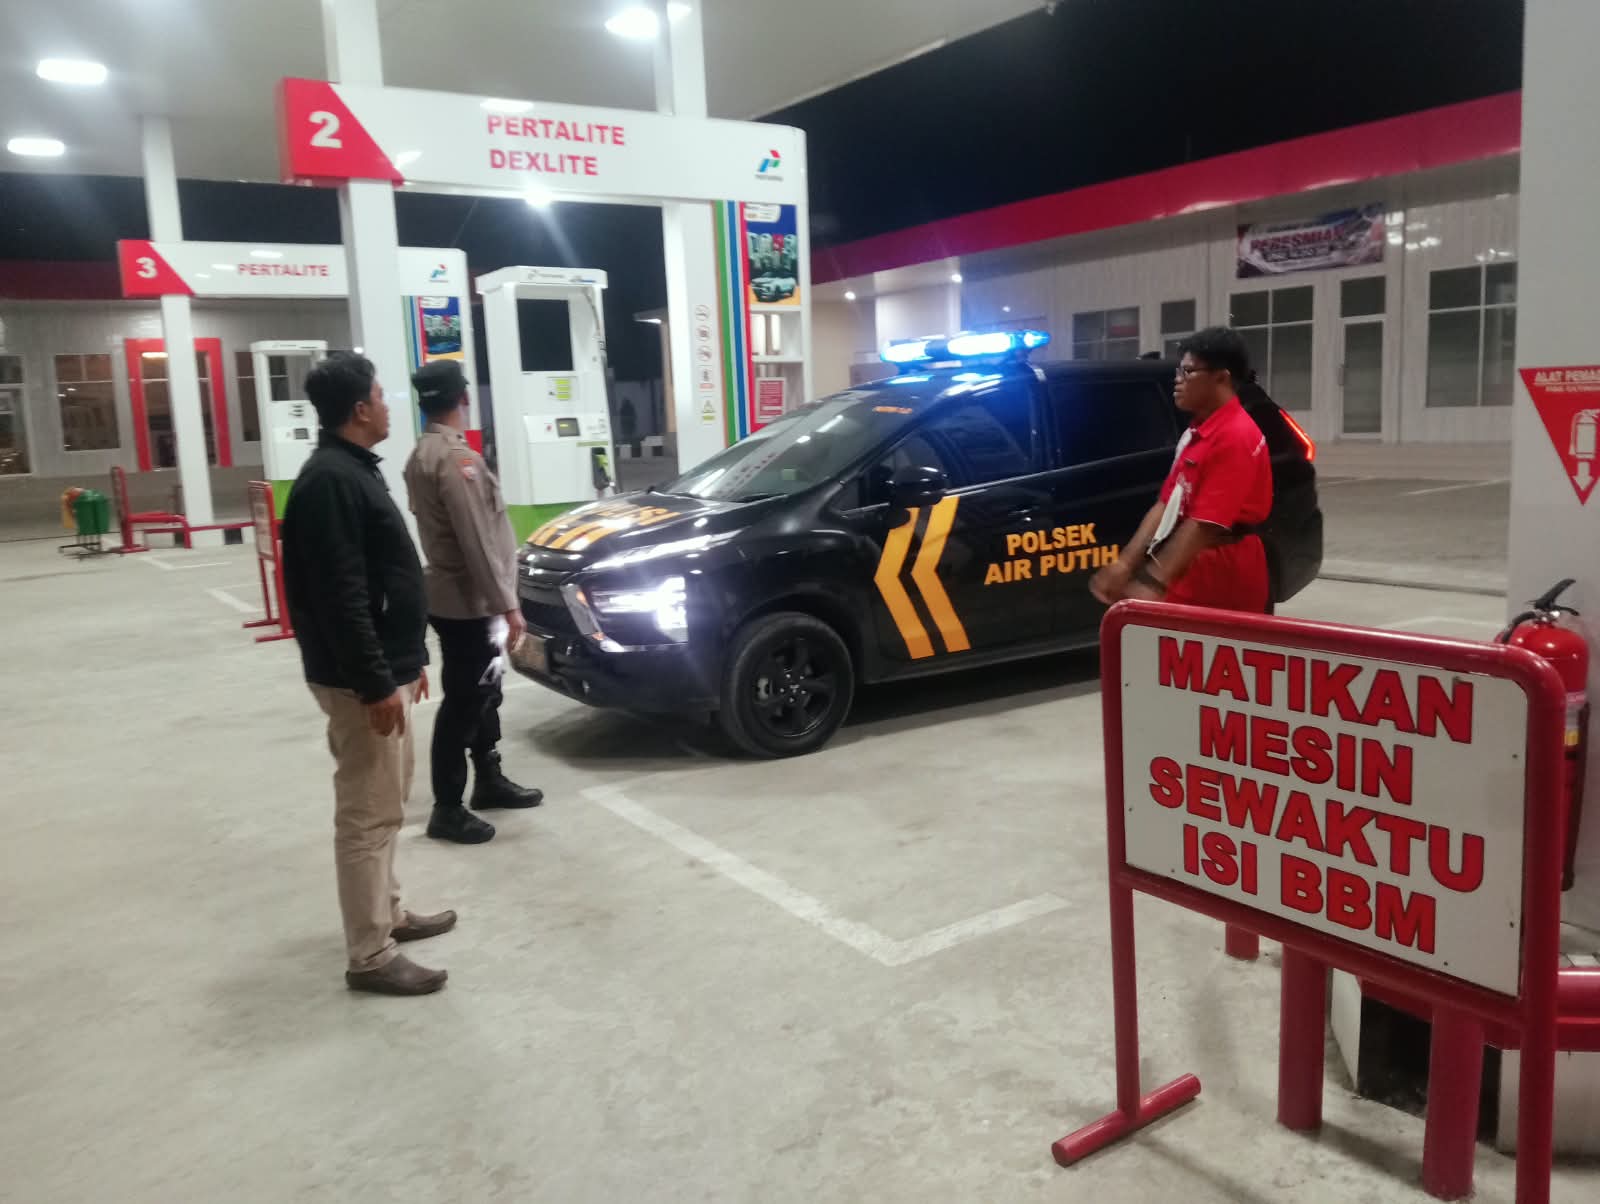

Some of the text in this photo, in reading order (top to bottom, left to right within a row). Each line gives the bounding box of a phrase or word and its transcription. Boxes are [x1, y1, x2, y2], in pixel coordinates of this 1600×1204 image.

[309, 111, 342, 149] 2
[487, 114, 625, 146] PERTALITE
[489, 149, 599, 176] DEXLITE
[136, 257, 158, 279] 3
[237, 263, 330, 277] PERTALITE
[1006, 523, 1097, 556] POLSEK
[983, 544, 1120, 585] AIR PUTIH
[1158, 636, 1474, 744] MATIKAN
[1198, 705, 1414, 805] MESIN
[1149, 757, 1485, 893] SEWAKTU
[1183, 825, 1437, 954] ISI BBM
